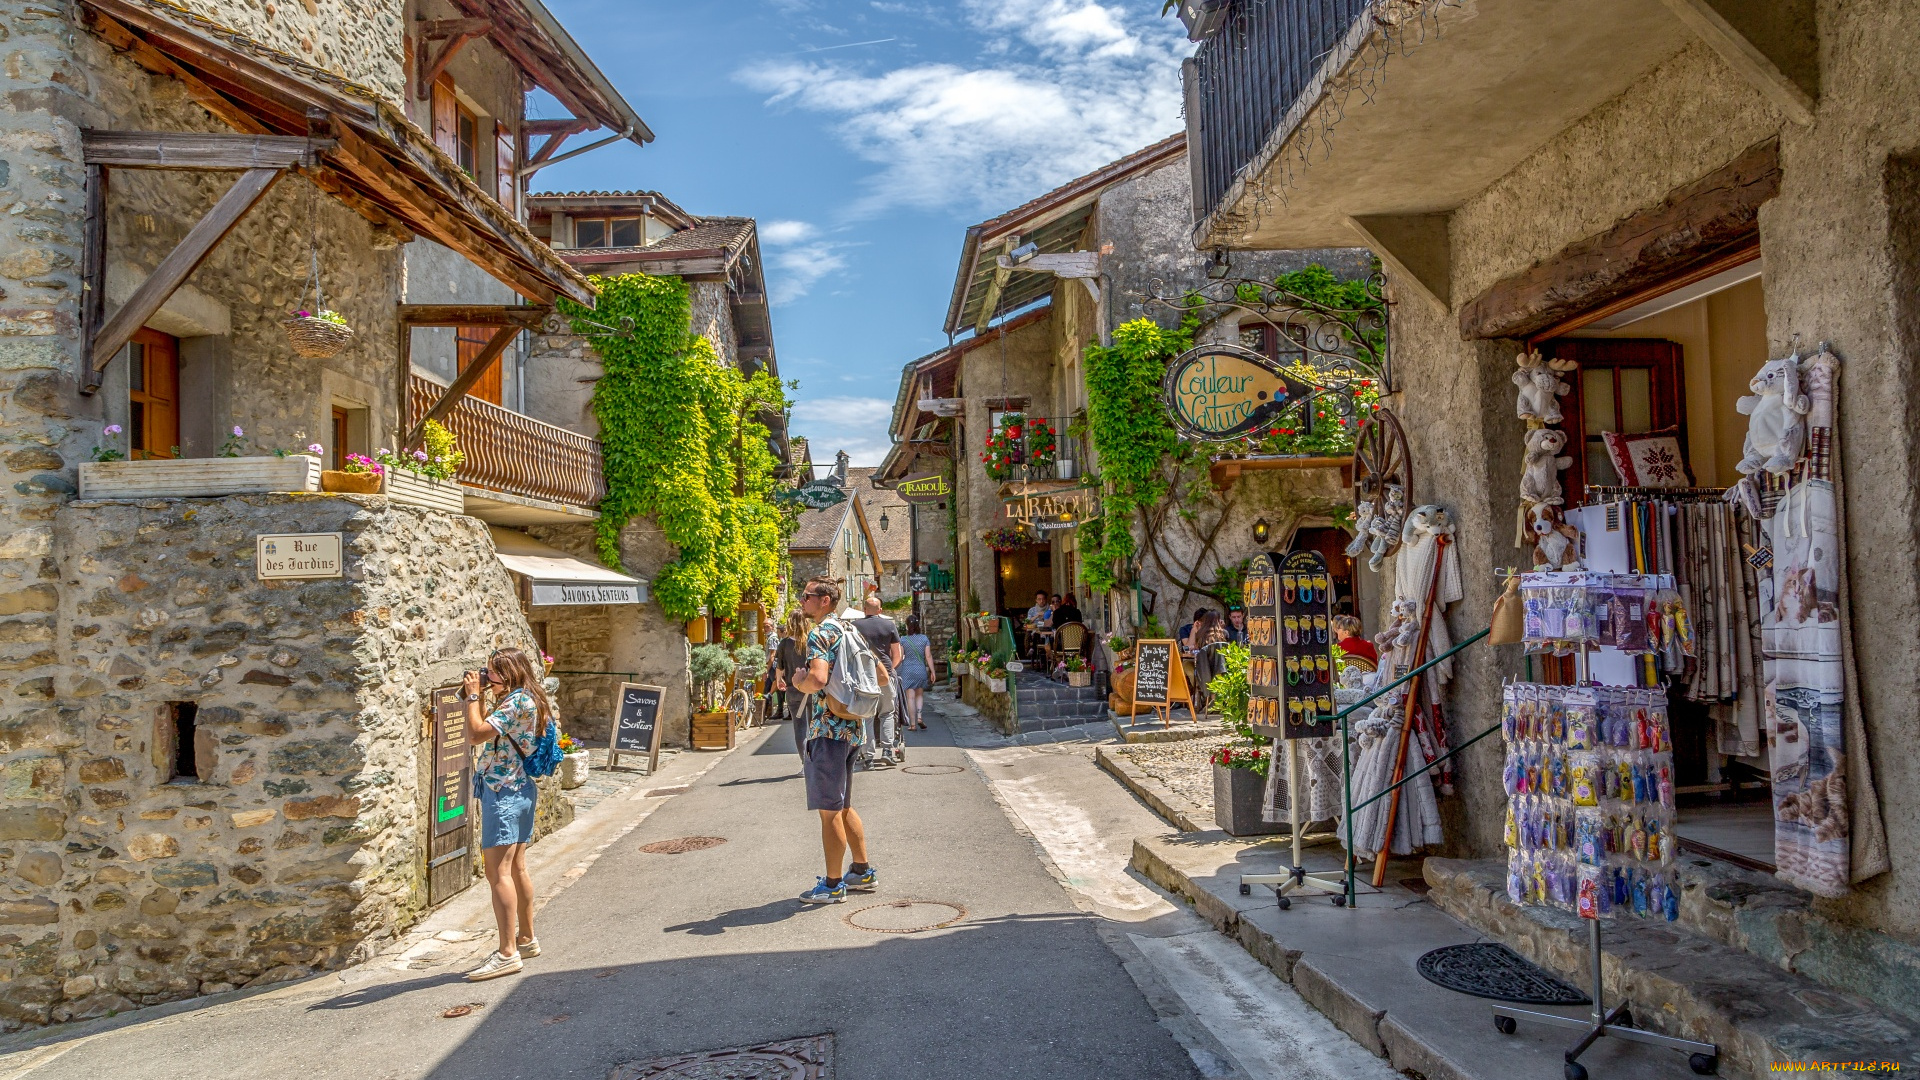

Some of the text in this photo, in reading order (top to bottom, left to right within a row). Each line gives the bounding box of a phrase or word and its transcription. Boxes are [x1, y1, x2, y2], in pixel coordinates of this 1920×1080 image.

[1178, 356, 1254, 395] Couleur
[1178, 394, 1255, 432] Nature
[800, 484, 836, 497] Restaurant
[1006, 503, 1023, 518] LA
[293, 539, 318, 552] Rue
[266, 557, 335, 571] des Jardins
[625, 693, 657, 705] Savons
[636, 709, 643, 717] &
